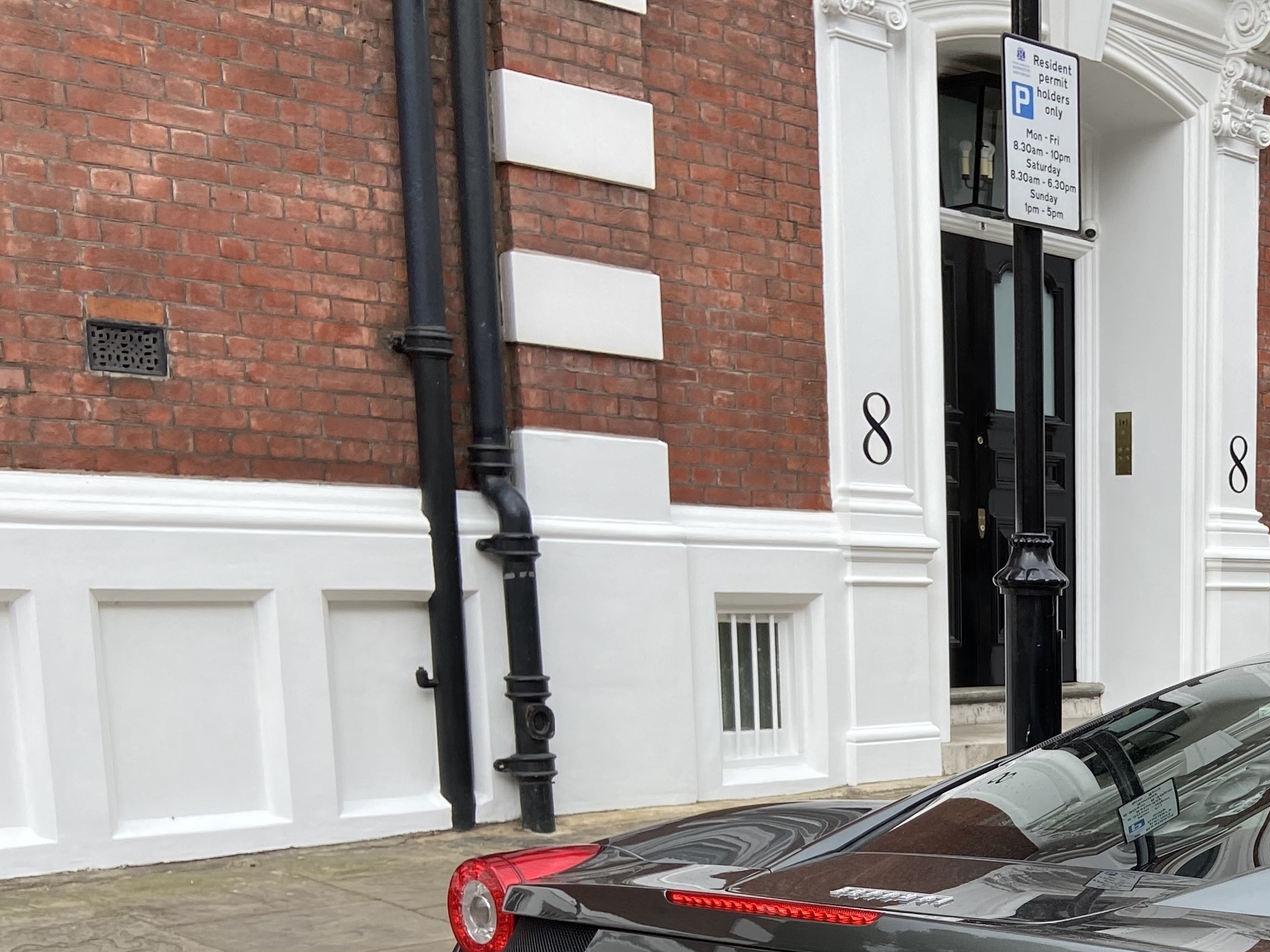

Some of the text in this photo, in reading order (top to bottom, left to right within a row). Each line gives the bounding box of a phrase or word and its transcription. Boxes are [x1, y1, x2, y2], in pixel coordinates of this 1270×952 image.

[1034, 54, 1072, 76] Resident
[1039, 72, 1068, 90] permit
[1015, 85, 1030, 114] P
[1037, 86, 1070, 106] holders
[1045, 106, 1063, 120] only
[1026, 128, 1043, 142] Mon
[1050, 134, 1060, 146] Fri
[1014, 140, 1044, 157] 8.30am
[1050, 150, 1071, 164] 10pm
[1026, 159, 1061, 176] Saturday
[1010, 170, 1040, 188] 8.30am
[1048, 178, 1076, 194] 6.30pm
[1030, 188, 1058, 205] Sunday
[1024, 203, 1040, 215] 1pm
[1046, 206, 1064, 220] 5pm
[862, 392, 892, 465] 8
[1229, 435, 1248, 493] 8
